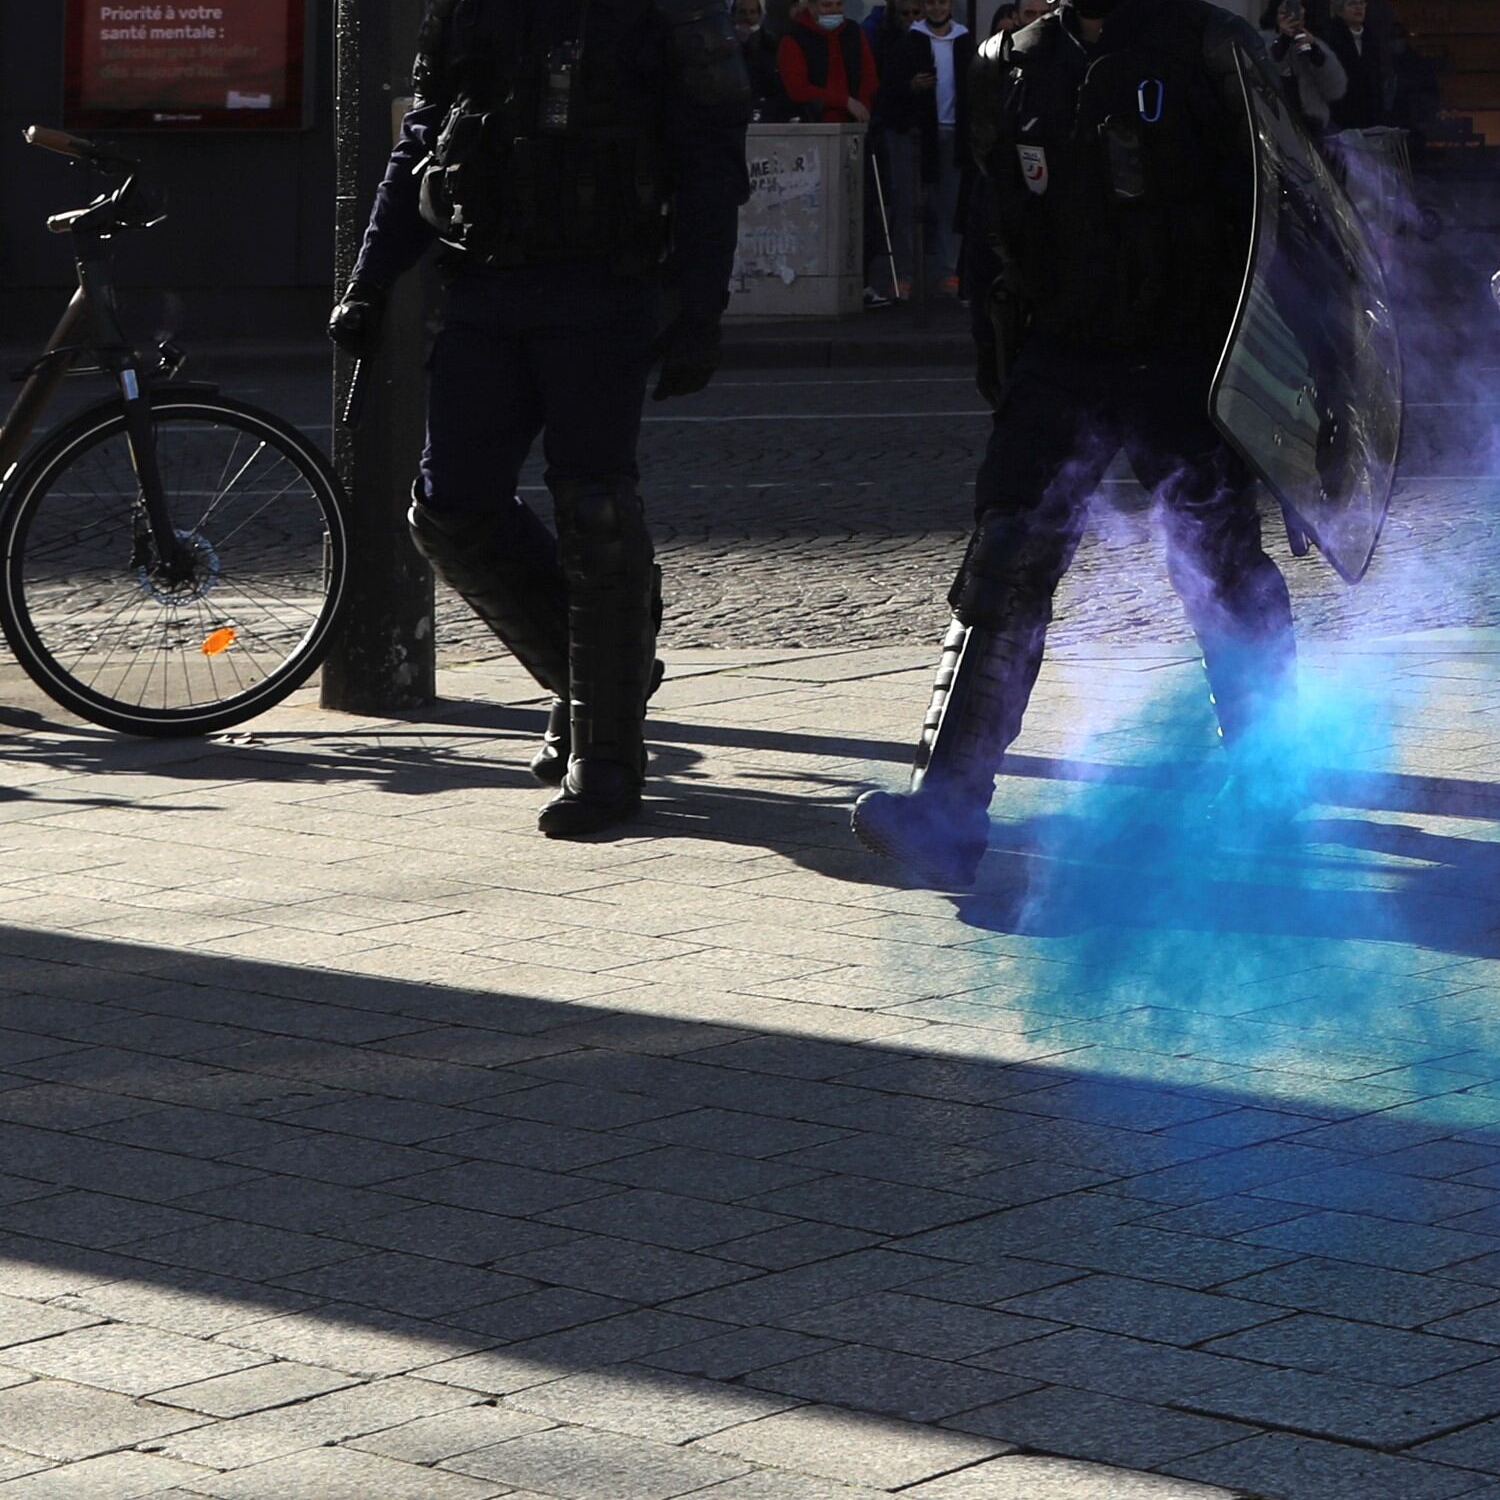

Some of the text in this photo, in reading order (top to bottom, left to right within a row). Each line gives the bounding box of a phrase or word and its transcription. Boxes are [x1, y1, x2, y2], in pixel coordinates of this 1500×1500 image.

[100, 5, 223, 20] Priorité à votre
[100, 25, 146, 40] santé
[150, 24, 217, 39] mentale
